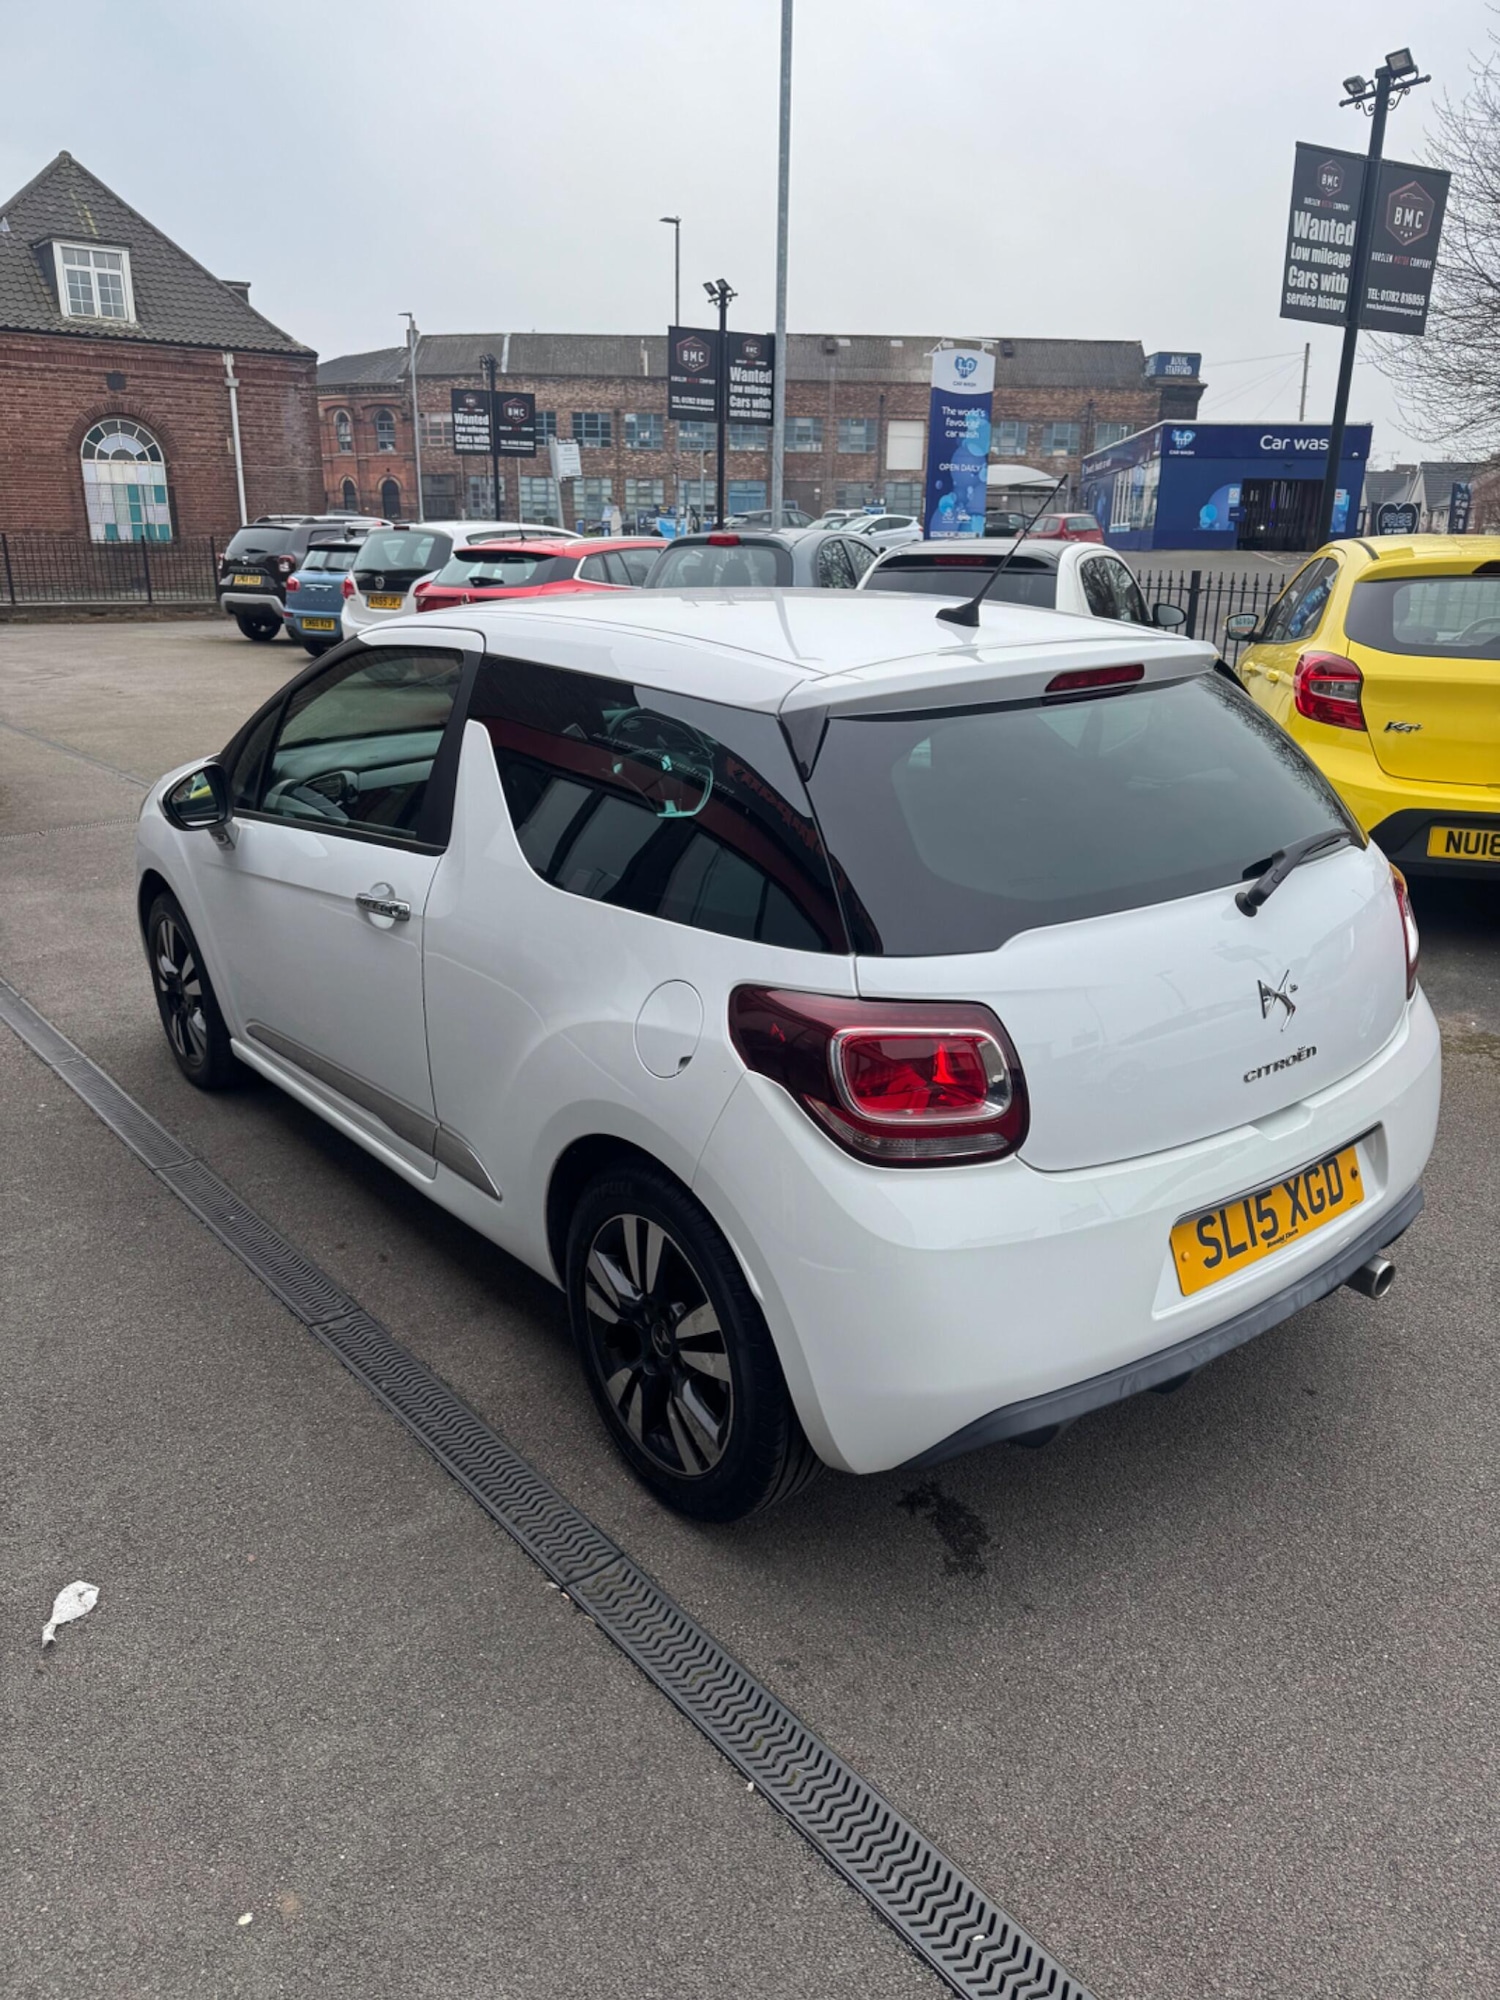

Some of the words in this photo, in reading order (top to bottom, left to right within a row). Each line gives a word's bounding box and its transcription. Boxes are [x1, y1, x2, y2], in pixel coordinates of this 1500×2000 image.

[1321, 173, 1340, 188] BMC
[1393, 206, 1424, 229] BMC
[1293, 210, 1357, 247] Wanted
[1290, 242, 1310, 262] Low
[1311, 248, 1351, 269] mileage
[1287, 265, 1319, 291] Cars
[1320, 272, 1349, 294] with
[1286, 292, 1317, 309] service
[1317, 295, 1346, 314] history
[682, 350, 705, 362] BMC
[729, 366, 773, 384] Wanted
[729, 383, 743, 394] Low
[744, 385, 772, 396] mileage
[729, 394, 751, 408] Cars
[752, 397, 772, 410] with
[507, 407, 525, 417] BMC
[941, 405, 957, 416] The
[454, 413, 489, 426] Wanted
[455, 433, 473, 444] Cars
[473, 435, 490, 444] with
[945, 430, 958, 438] car
[1260, 434, 1291, 450] Car
[1293, 438, 1329, 450] was
[939, 463, 960, 472] OPEN
[1196, 1189, 1279, 1269] SL15
[1283, 1156, 1344, 1228] XGD
